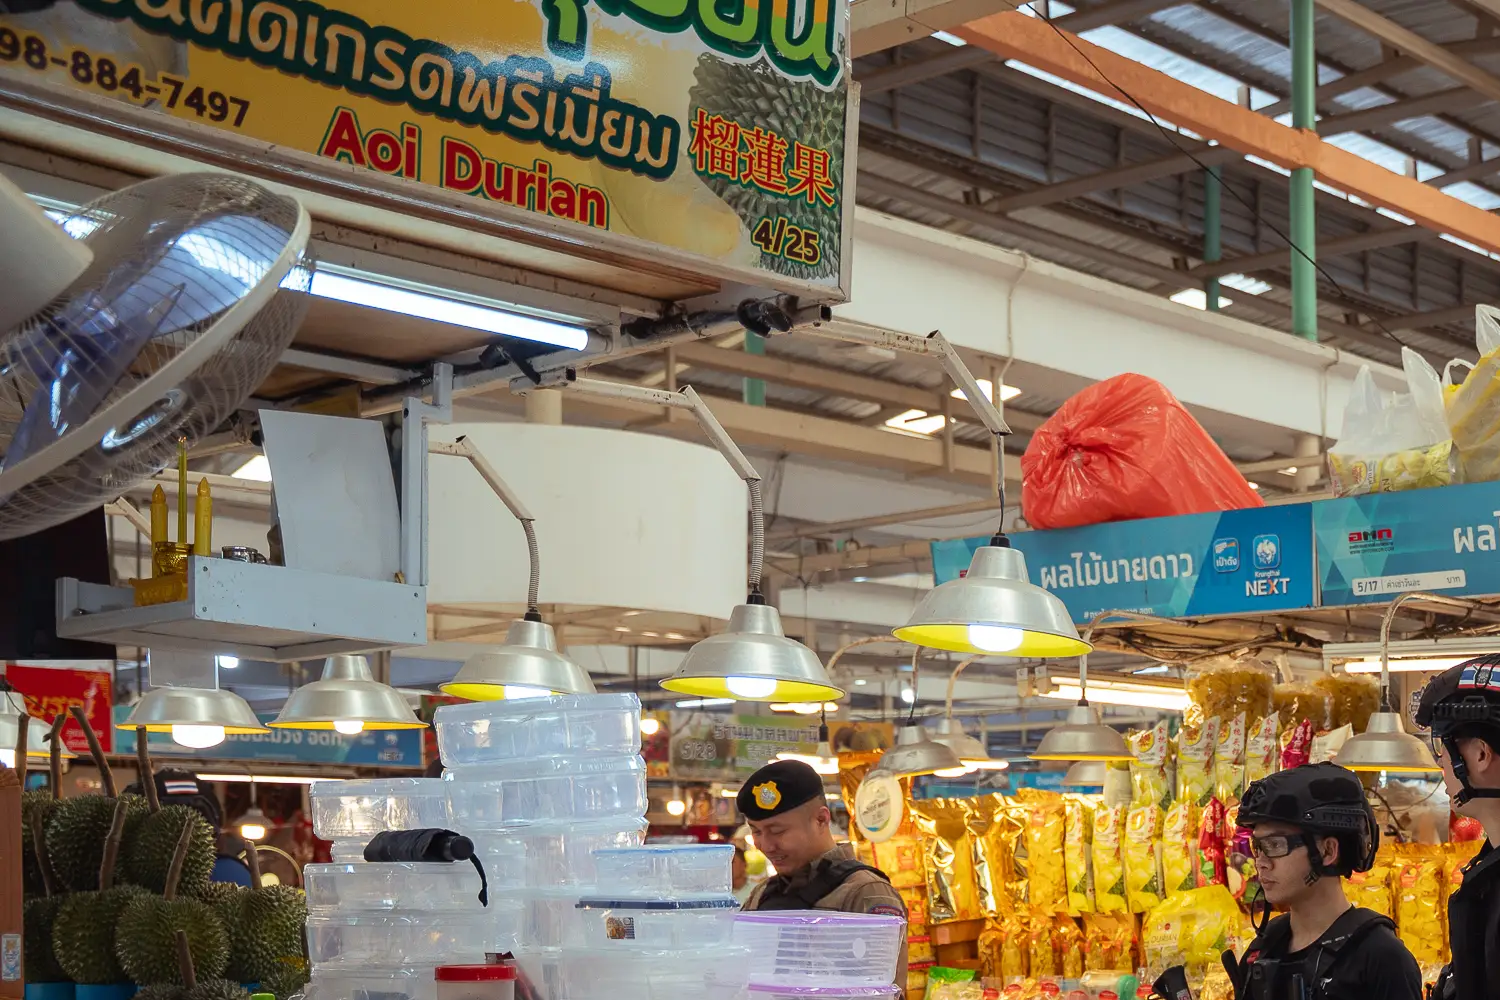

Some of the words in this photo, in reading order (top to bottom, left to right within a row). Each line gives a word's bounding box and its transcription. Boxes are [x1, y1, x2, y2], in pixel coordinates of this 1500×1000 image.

[322, 110, 420, 179] Aoi
[444, 140, 607, 229] Durian
[692, 108, 835, 207] 榴蓮果
[753, 219, 820, 265] 4/25
[1040, 552, 1195, 590] ผลไม้นายดาว
[1254, 570, 1281, 578] Krungthai
[1446, 574, 1462, 585] บาท
[1245, 578, 1290, 597] NEXT
[1357, 580, 1379, 593] 5/17
